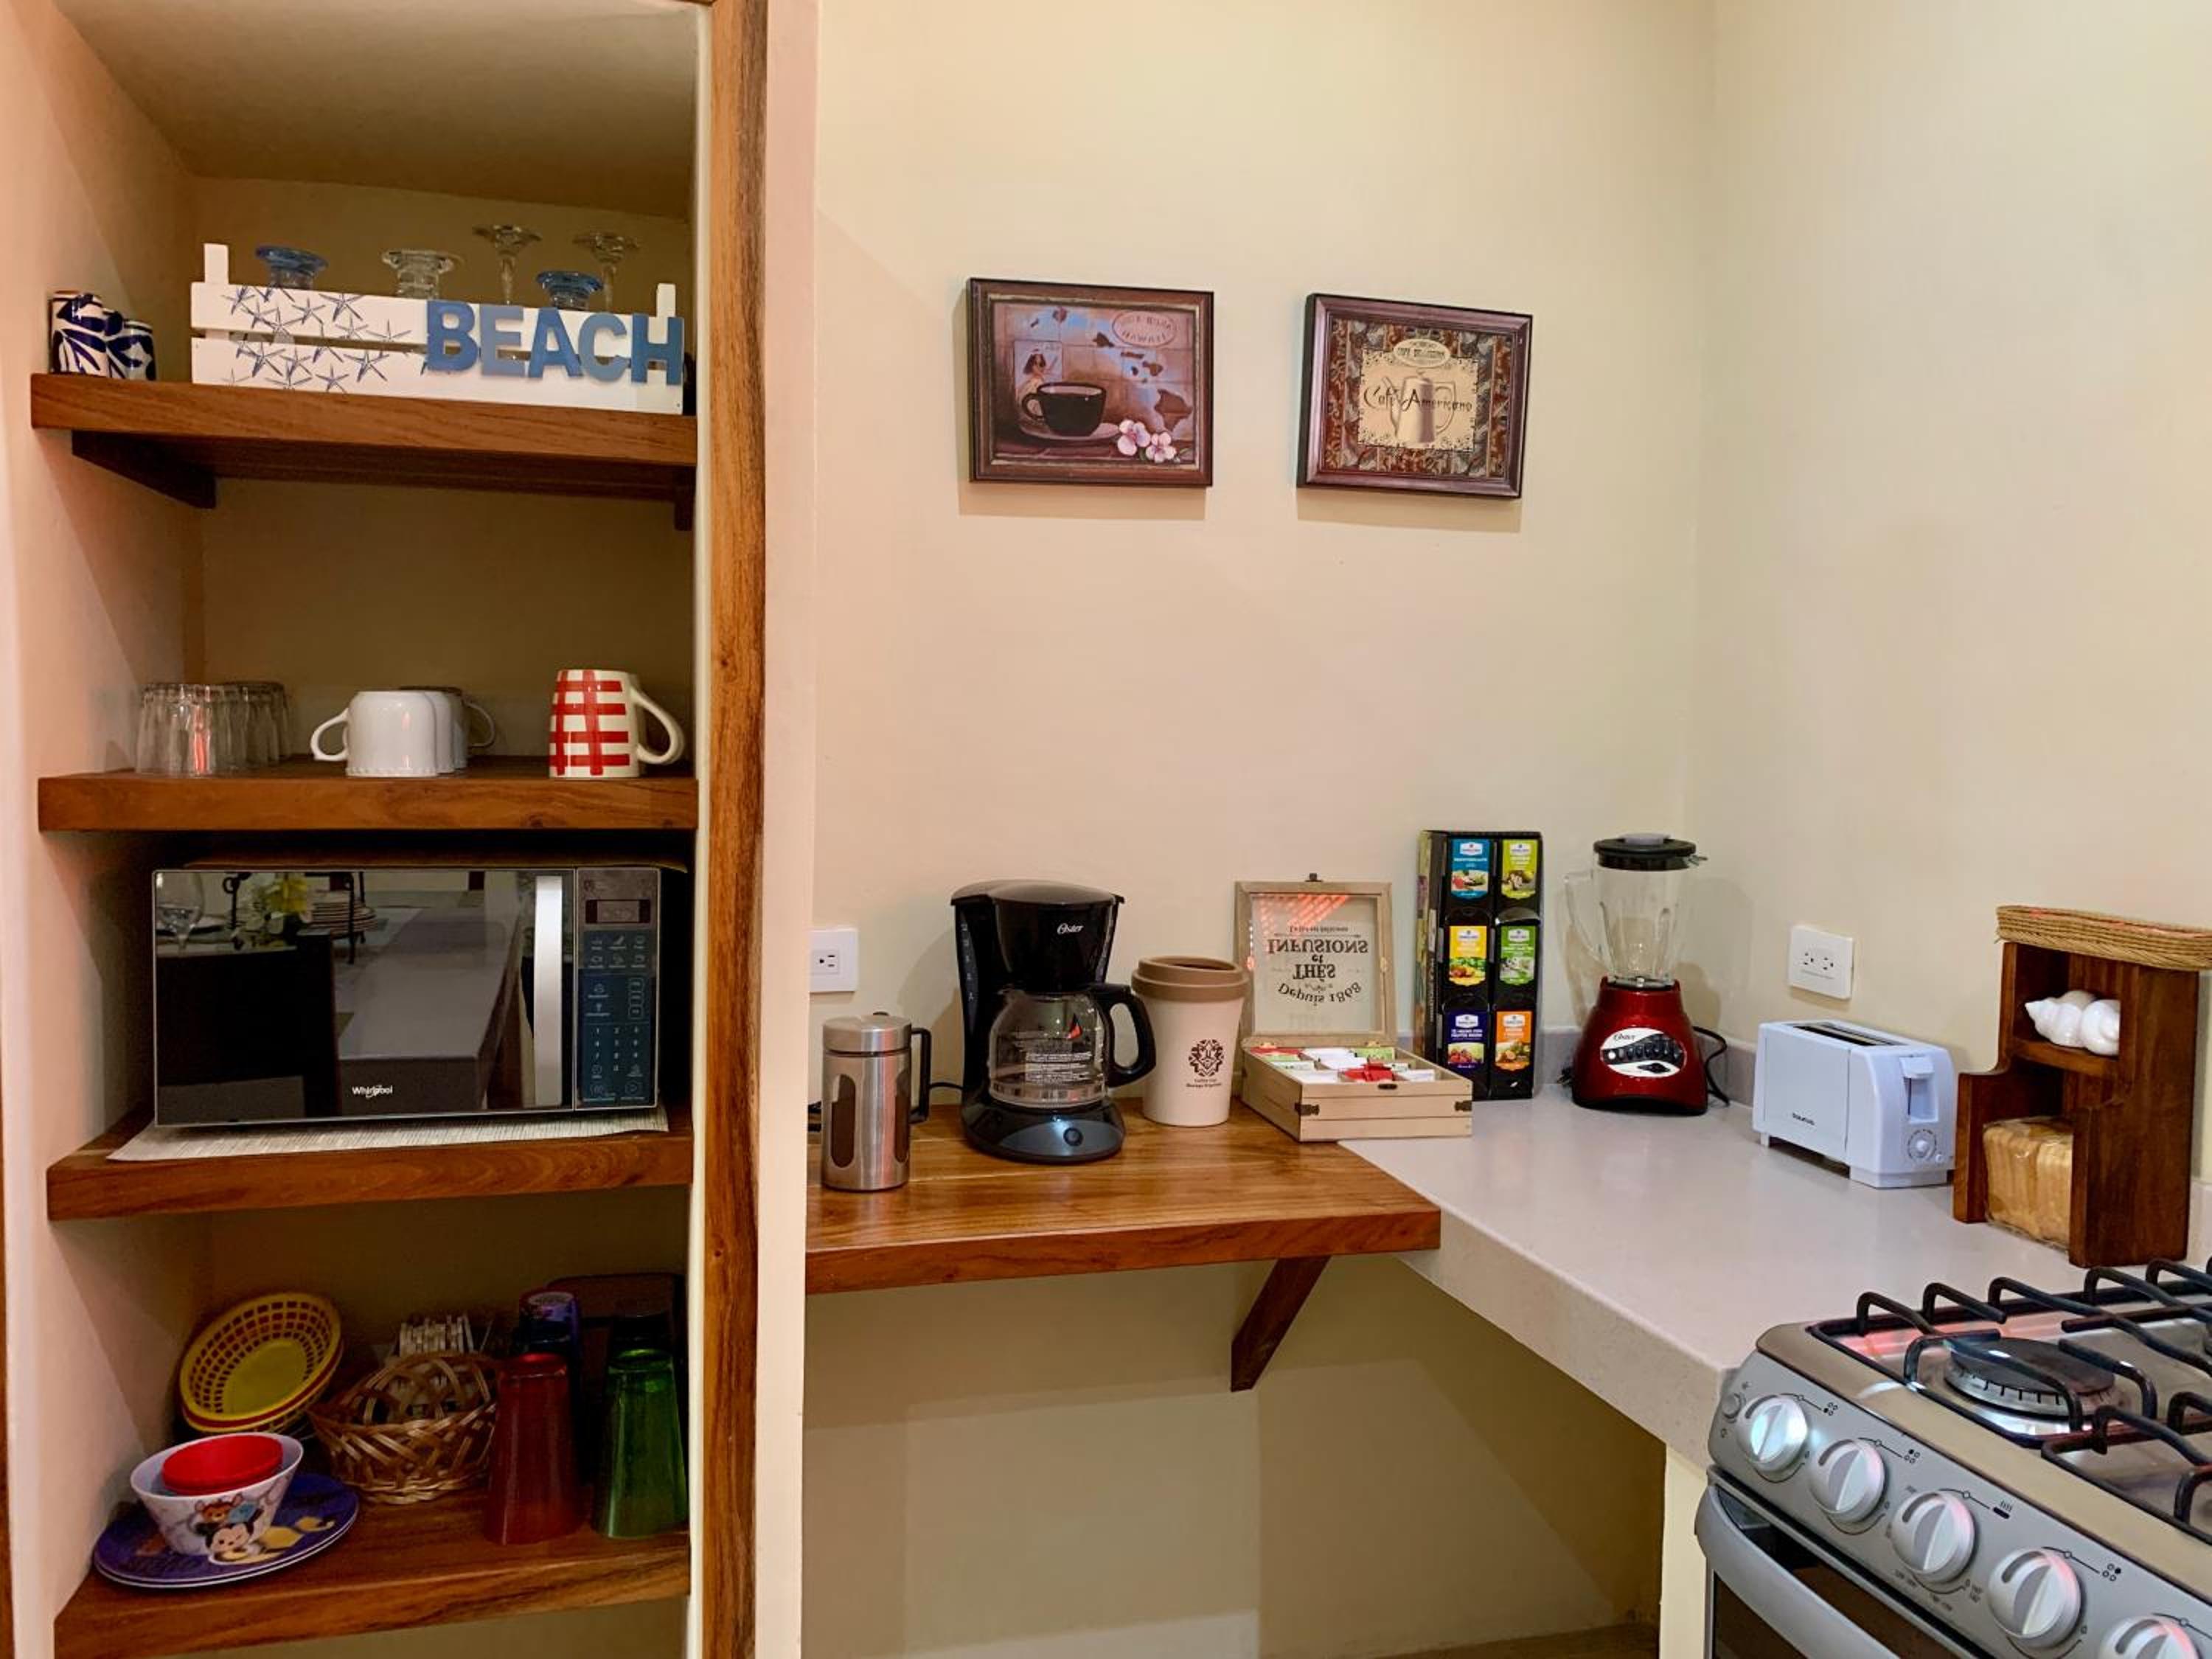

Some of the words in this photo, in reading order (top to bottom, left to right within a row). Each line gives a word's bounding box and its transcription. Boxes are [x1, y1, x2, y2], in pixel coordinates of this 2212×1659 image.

[426, 300, 684, 386] BEACH
[1057, 922, 1084, 935] Oster
[352, 1085, 394, 1099] Whirlpool
